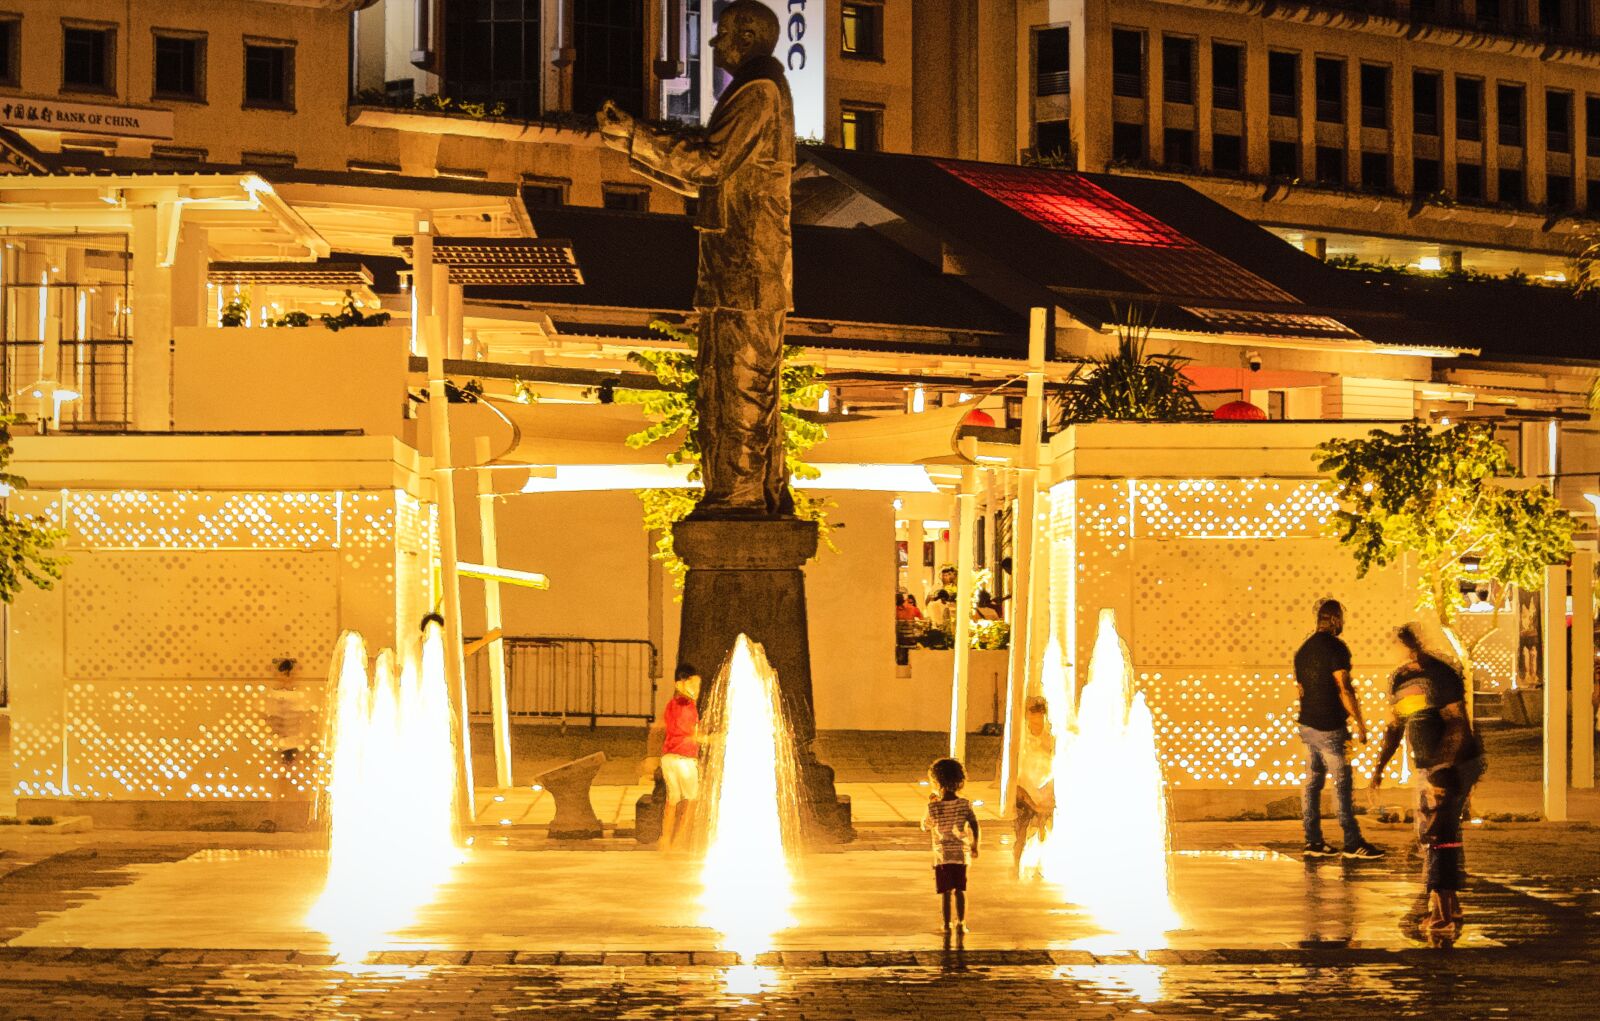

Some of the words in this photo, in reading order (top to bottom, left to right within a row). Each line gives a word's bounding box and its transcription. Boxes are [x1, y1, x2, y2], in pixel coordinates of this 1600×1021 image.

[56, 110, 86, 124] BANK
[88, 112, 102, 125] OF
[104, 115, 140, 128] CHINA
